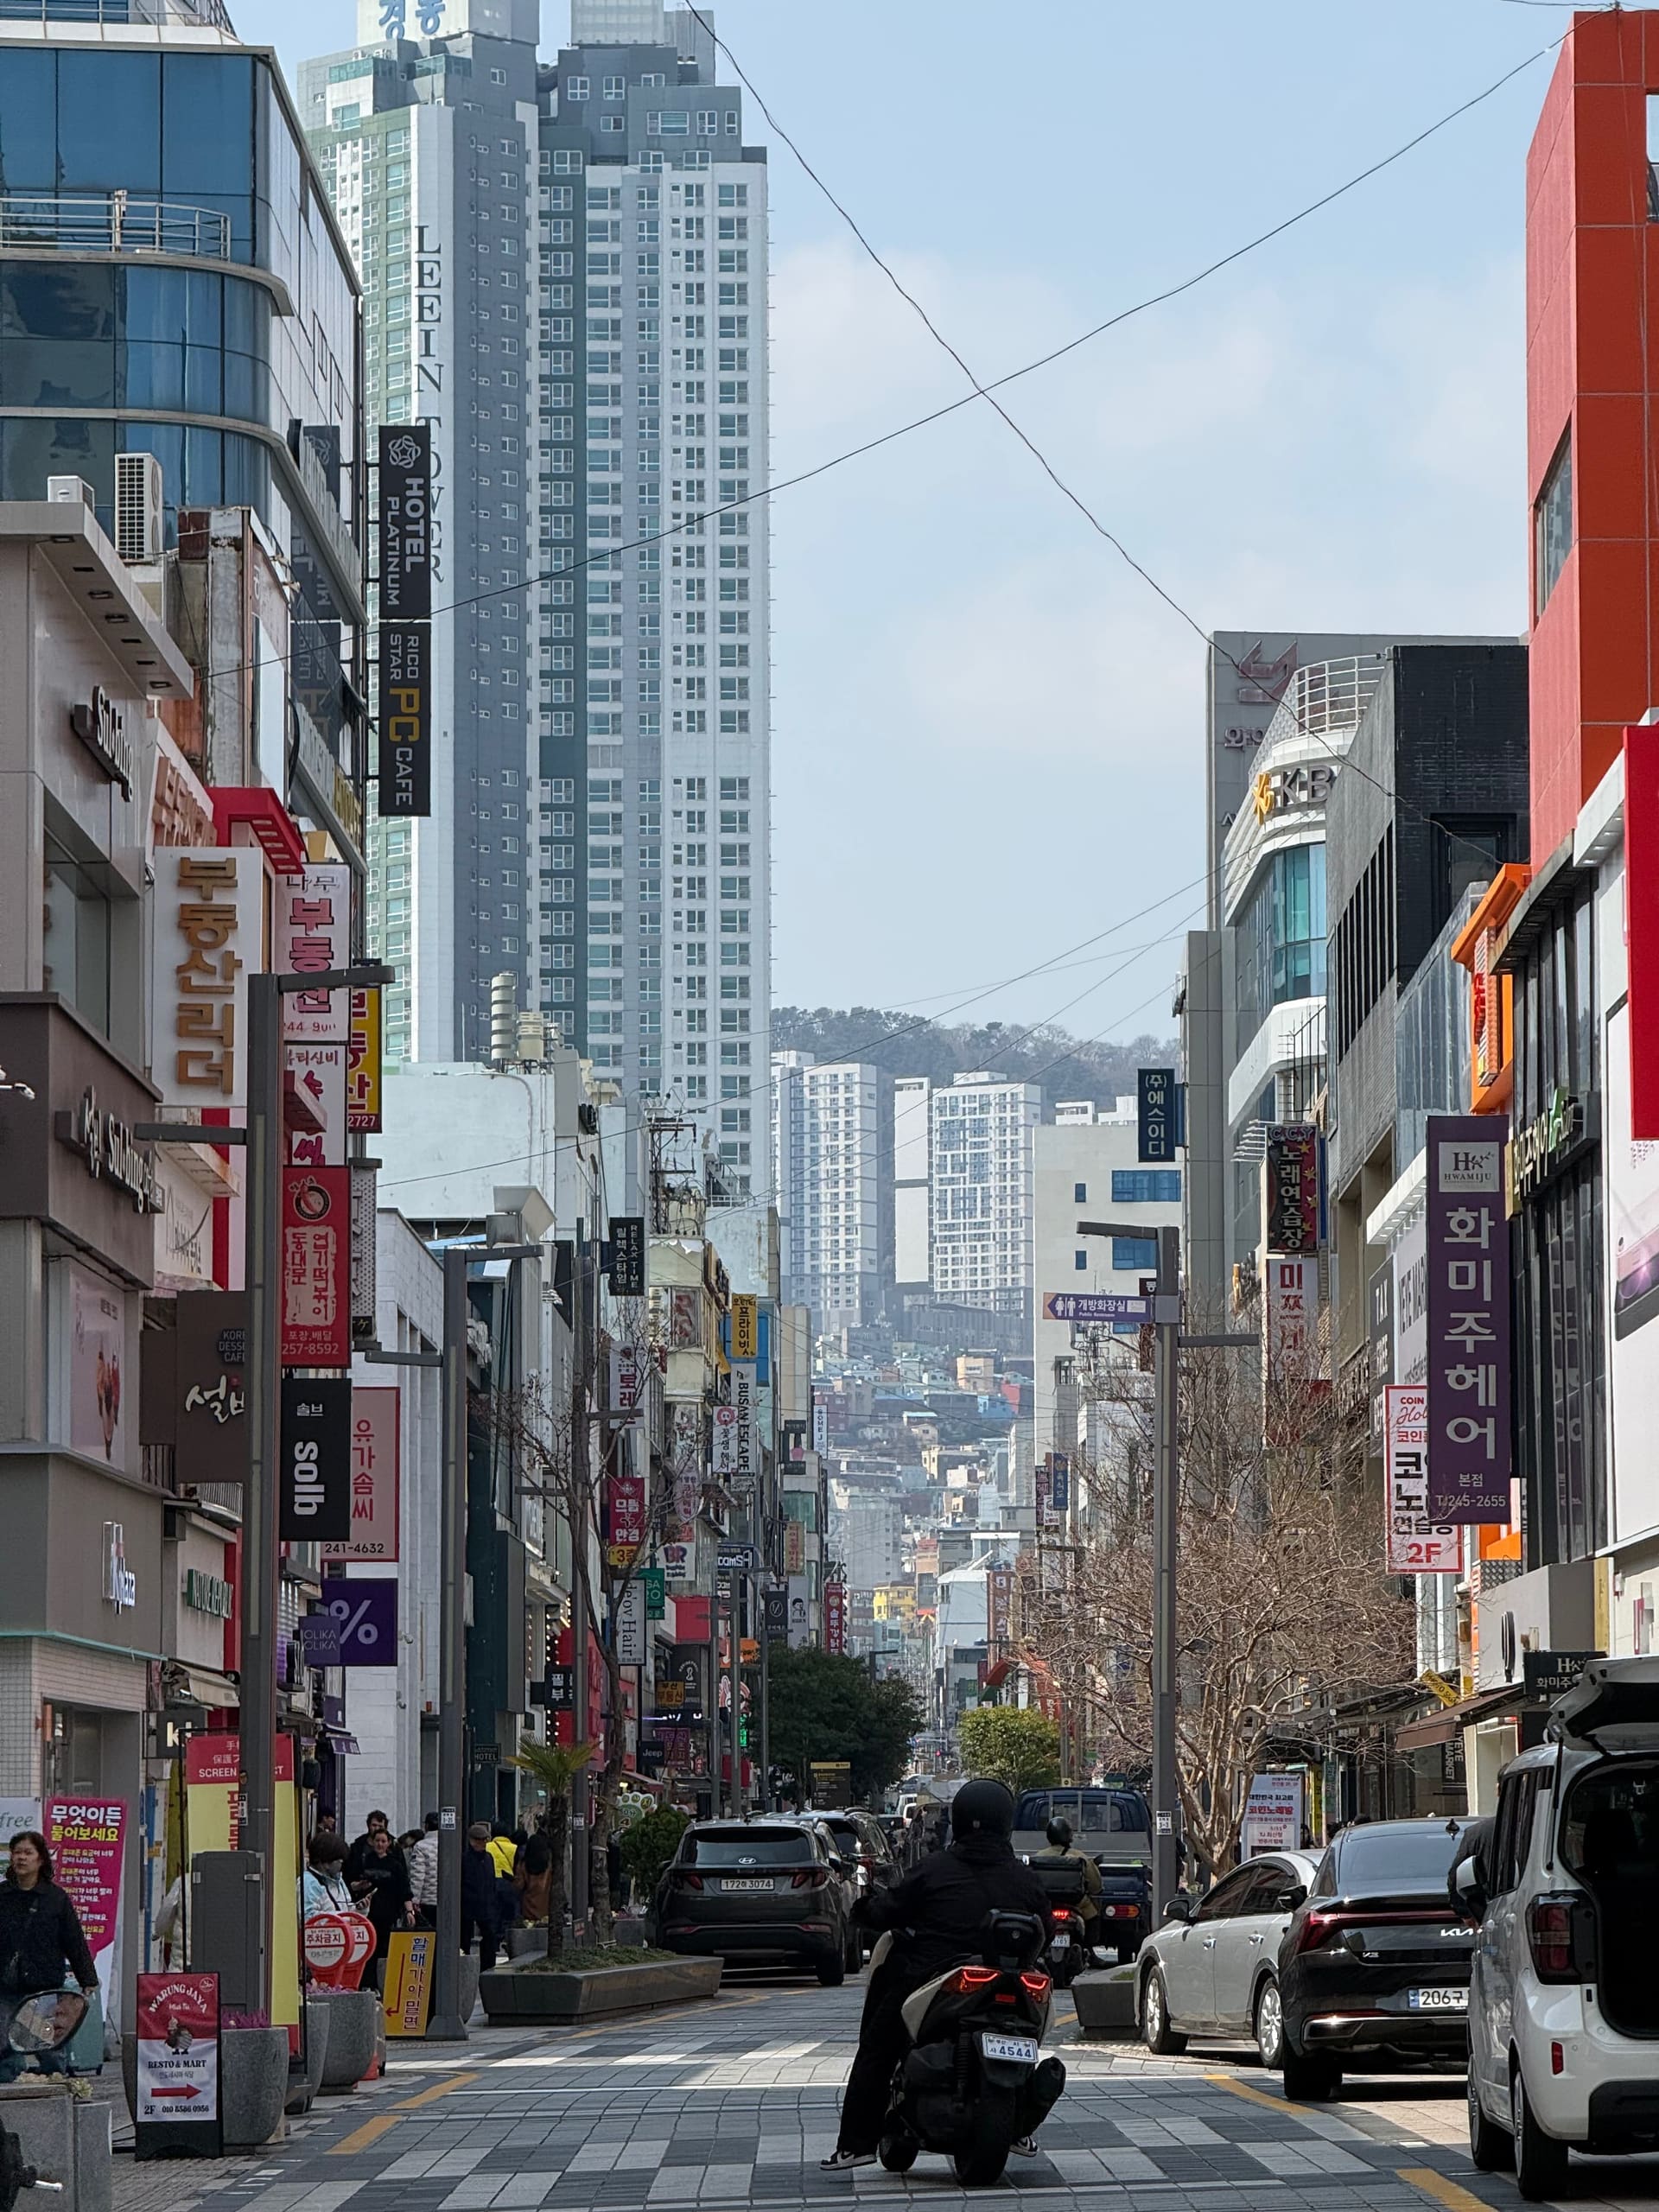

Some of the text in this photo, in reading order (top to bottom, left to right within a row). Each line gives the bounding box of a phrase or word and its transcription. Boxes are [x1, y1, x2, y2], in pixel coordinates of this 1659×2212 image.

[415, 225, 444, 394] LEEIN
[405, 477, 424, 573] HOTEL
[387, 497, 400, 605] PLATINUM
[389, 633, 402, 681] STAR
[406, 635, 419, 679] RICO
[389, 688, 420, 806] PC CAFE
[177, 857, 243, 1095] 부동산리더
[1145, 1075, 1167, 1155] (주)에스이디
[1444, 1173, 1492, 1182] HWAMIJU
[1280, 1146, 1306, 1249] 노래연습장
[291, 1232, 308, 1285] 동대문
[630, 1224, 639, 1288] RELAX TIME
[1077, 1299, 1126, 1312] 개방화장실
[1444, 1207, 1497, 1459] 화미주헤어
[282, 1344, 340, 1355] 257-8592
[1400, 1396, 1424, 1405] COIN
[739, 1382, 749, 1474] BUSAN ESCAPE
[1397, 1430, 1428, 1443] 코인
[1459, 1473, 1484, 1488] 본점
[615, 1528, 639, 1542] 안경
[325, 1542, 385, 1554] 241-4632
[1408, 1542, 1442, 1564] 2F
[621, 1619, 637, 1656] Hair
[1536, 1677, 1572, 1689] 화미주
[643, 1749, 663, 1758] Jeep
[1446, 1742, 1455, 1780] MARKET
[199, 1768, 237, 1777] SCREEN
[50, 1804, 122, 1826] 무엇이든
[1249, 1806, 1294, 1815] 코인노래방
[50, 1826, 119, 1841] 물어보세요
[306, 1934, 340, 1944] 주차금지
[148, 1983, 207, 2014] WARUNG JAYA
[999, 2045, 1032, 2058] 4544
[148, 2059, 207, 2069] RESTO & MART
[144, 2105, 156, 2115] 2F
